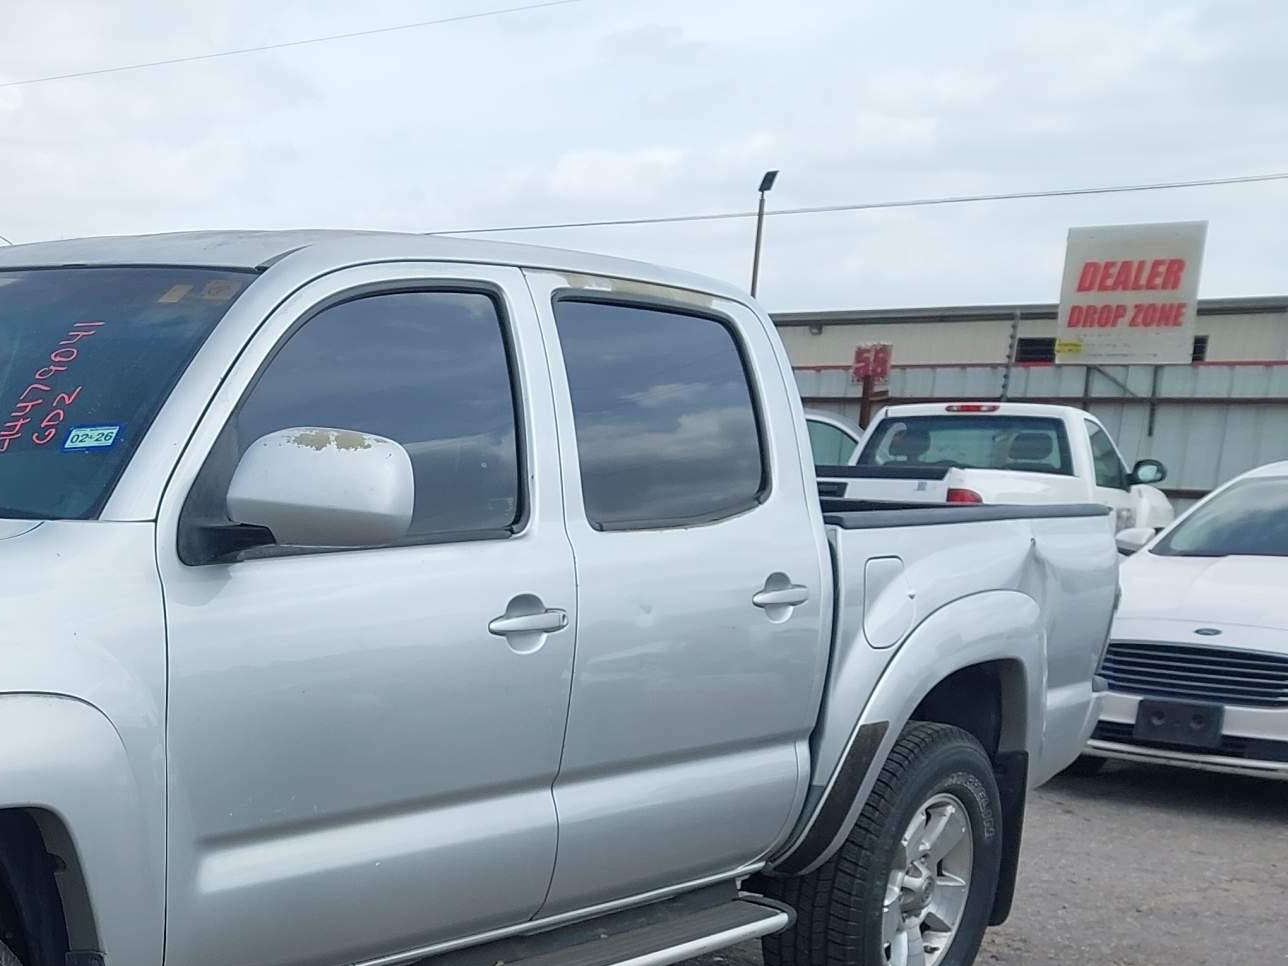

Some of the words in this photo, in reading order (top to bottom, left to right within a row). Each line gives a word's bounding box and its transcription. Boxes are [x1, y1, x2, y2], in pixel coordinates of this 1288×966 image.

[1076, 258, 1186, 293] DEALER
[1067, 303, 1127, 328] DROP
[1128, 302, 1187, 328] ZONE
